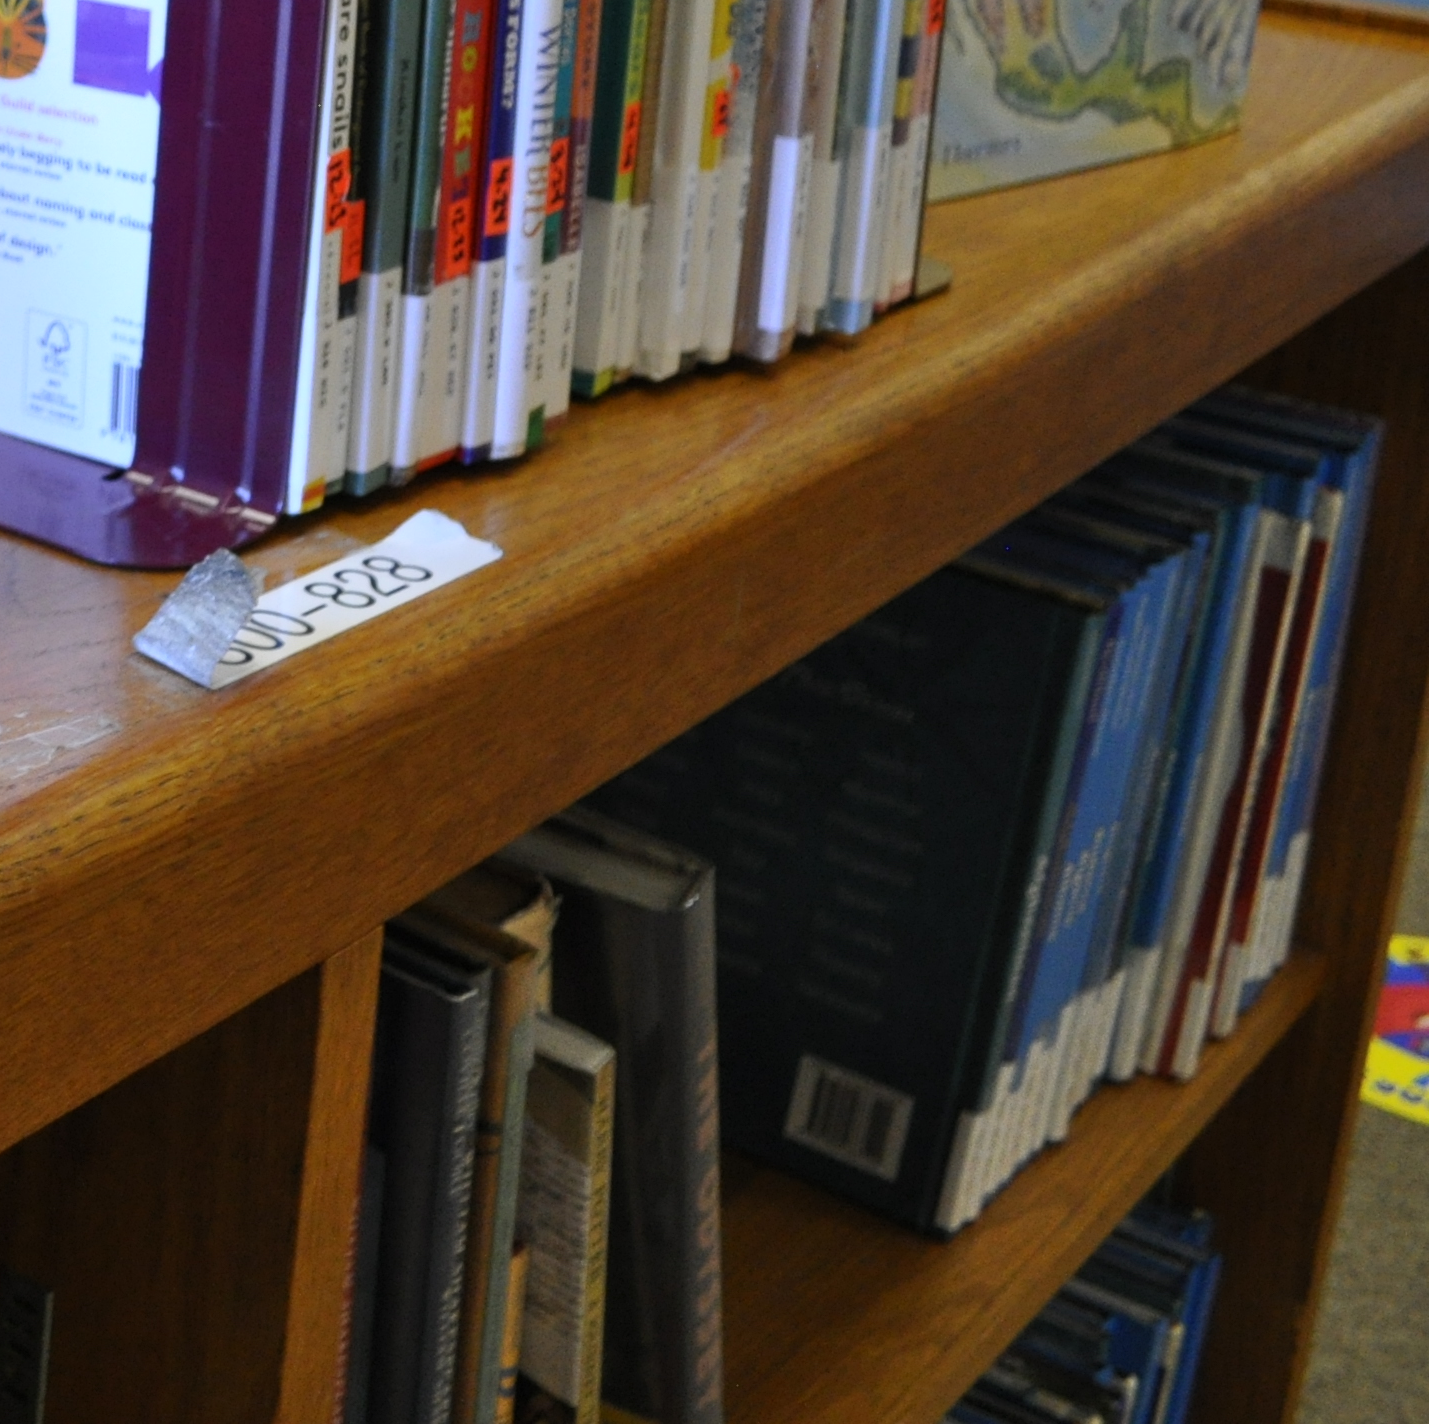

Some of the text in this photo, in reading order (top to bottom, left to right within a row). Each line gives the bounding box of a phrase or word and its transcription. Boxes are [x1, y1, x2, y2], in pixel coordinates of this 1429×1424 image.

[331, 54, 350, 150] snails
[501, 14, 520, 110] FORM?
[525, 29, 558, 156] WINTER
[19, 146, 74, 172] begging
[77, 157, 93, 173] to
[95, 162, 113, 177] be
[115, 167, 148, 184] read
[34, 195, 86, 220] naming
[89, 206, 117, 225] and
